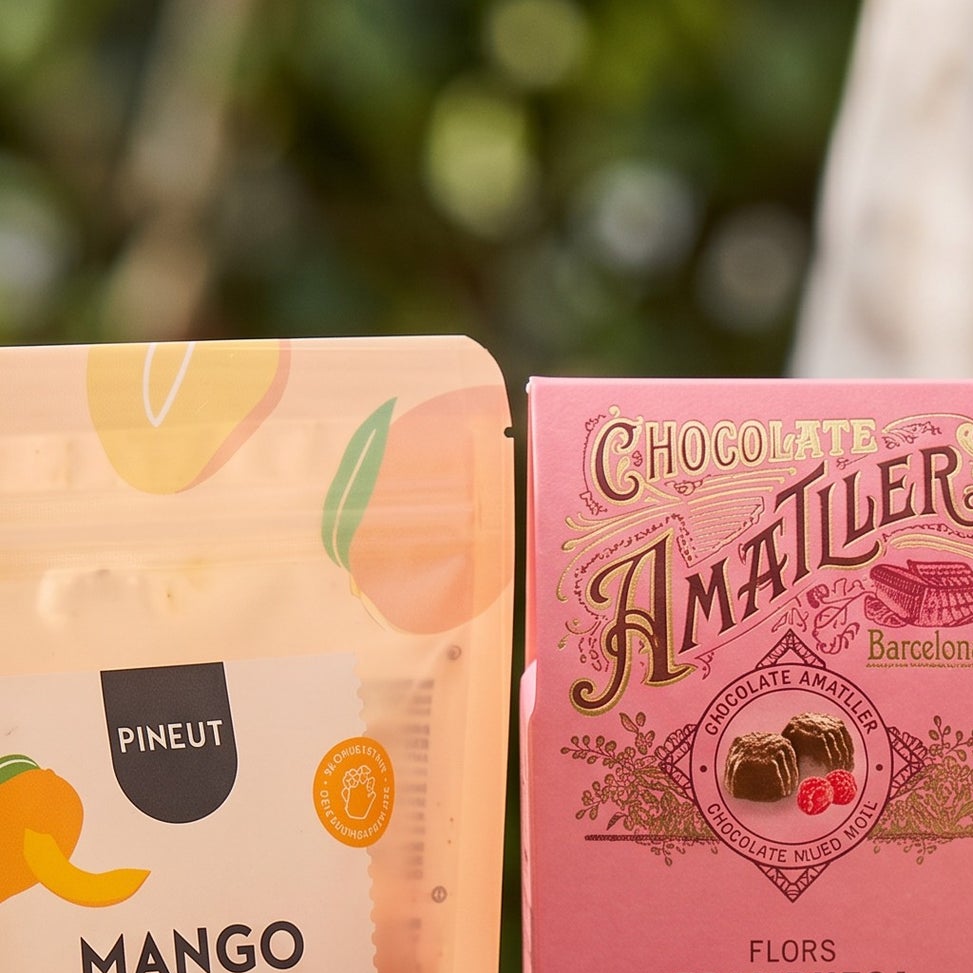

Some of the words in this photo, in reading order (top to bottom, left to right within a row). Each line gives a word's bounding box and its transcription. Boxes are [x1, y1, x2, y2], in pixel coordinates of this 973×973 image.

[590, 408, 878, 501] CHOCOLATE
[799, 670, 878, 735] AMATLLER
[117, 719, 224, 753] PINEUT
[707, 802, 787, 863] CHOCOLATE
[750, 939, 837, 962] FLORS
